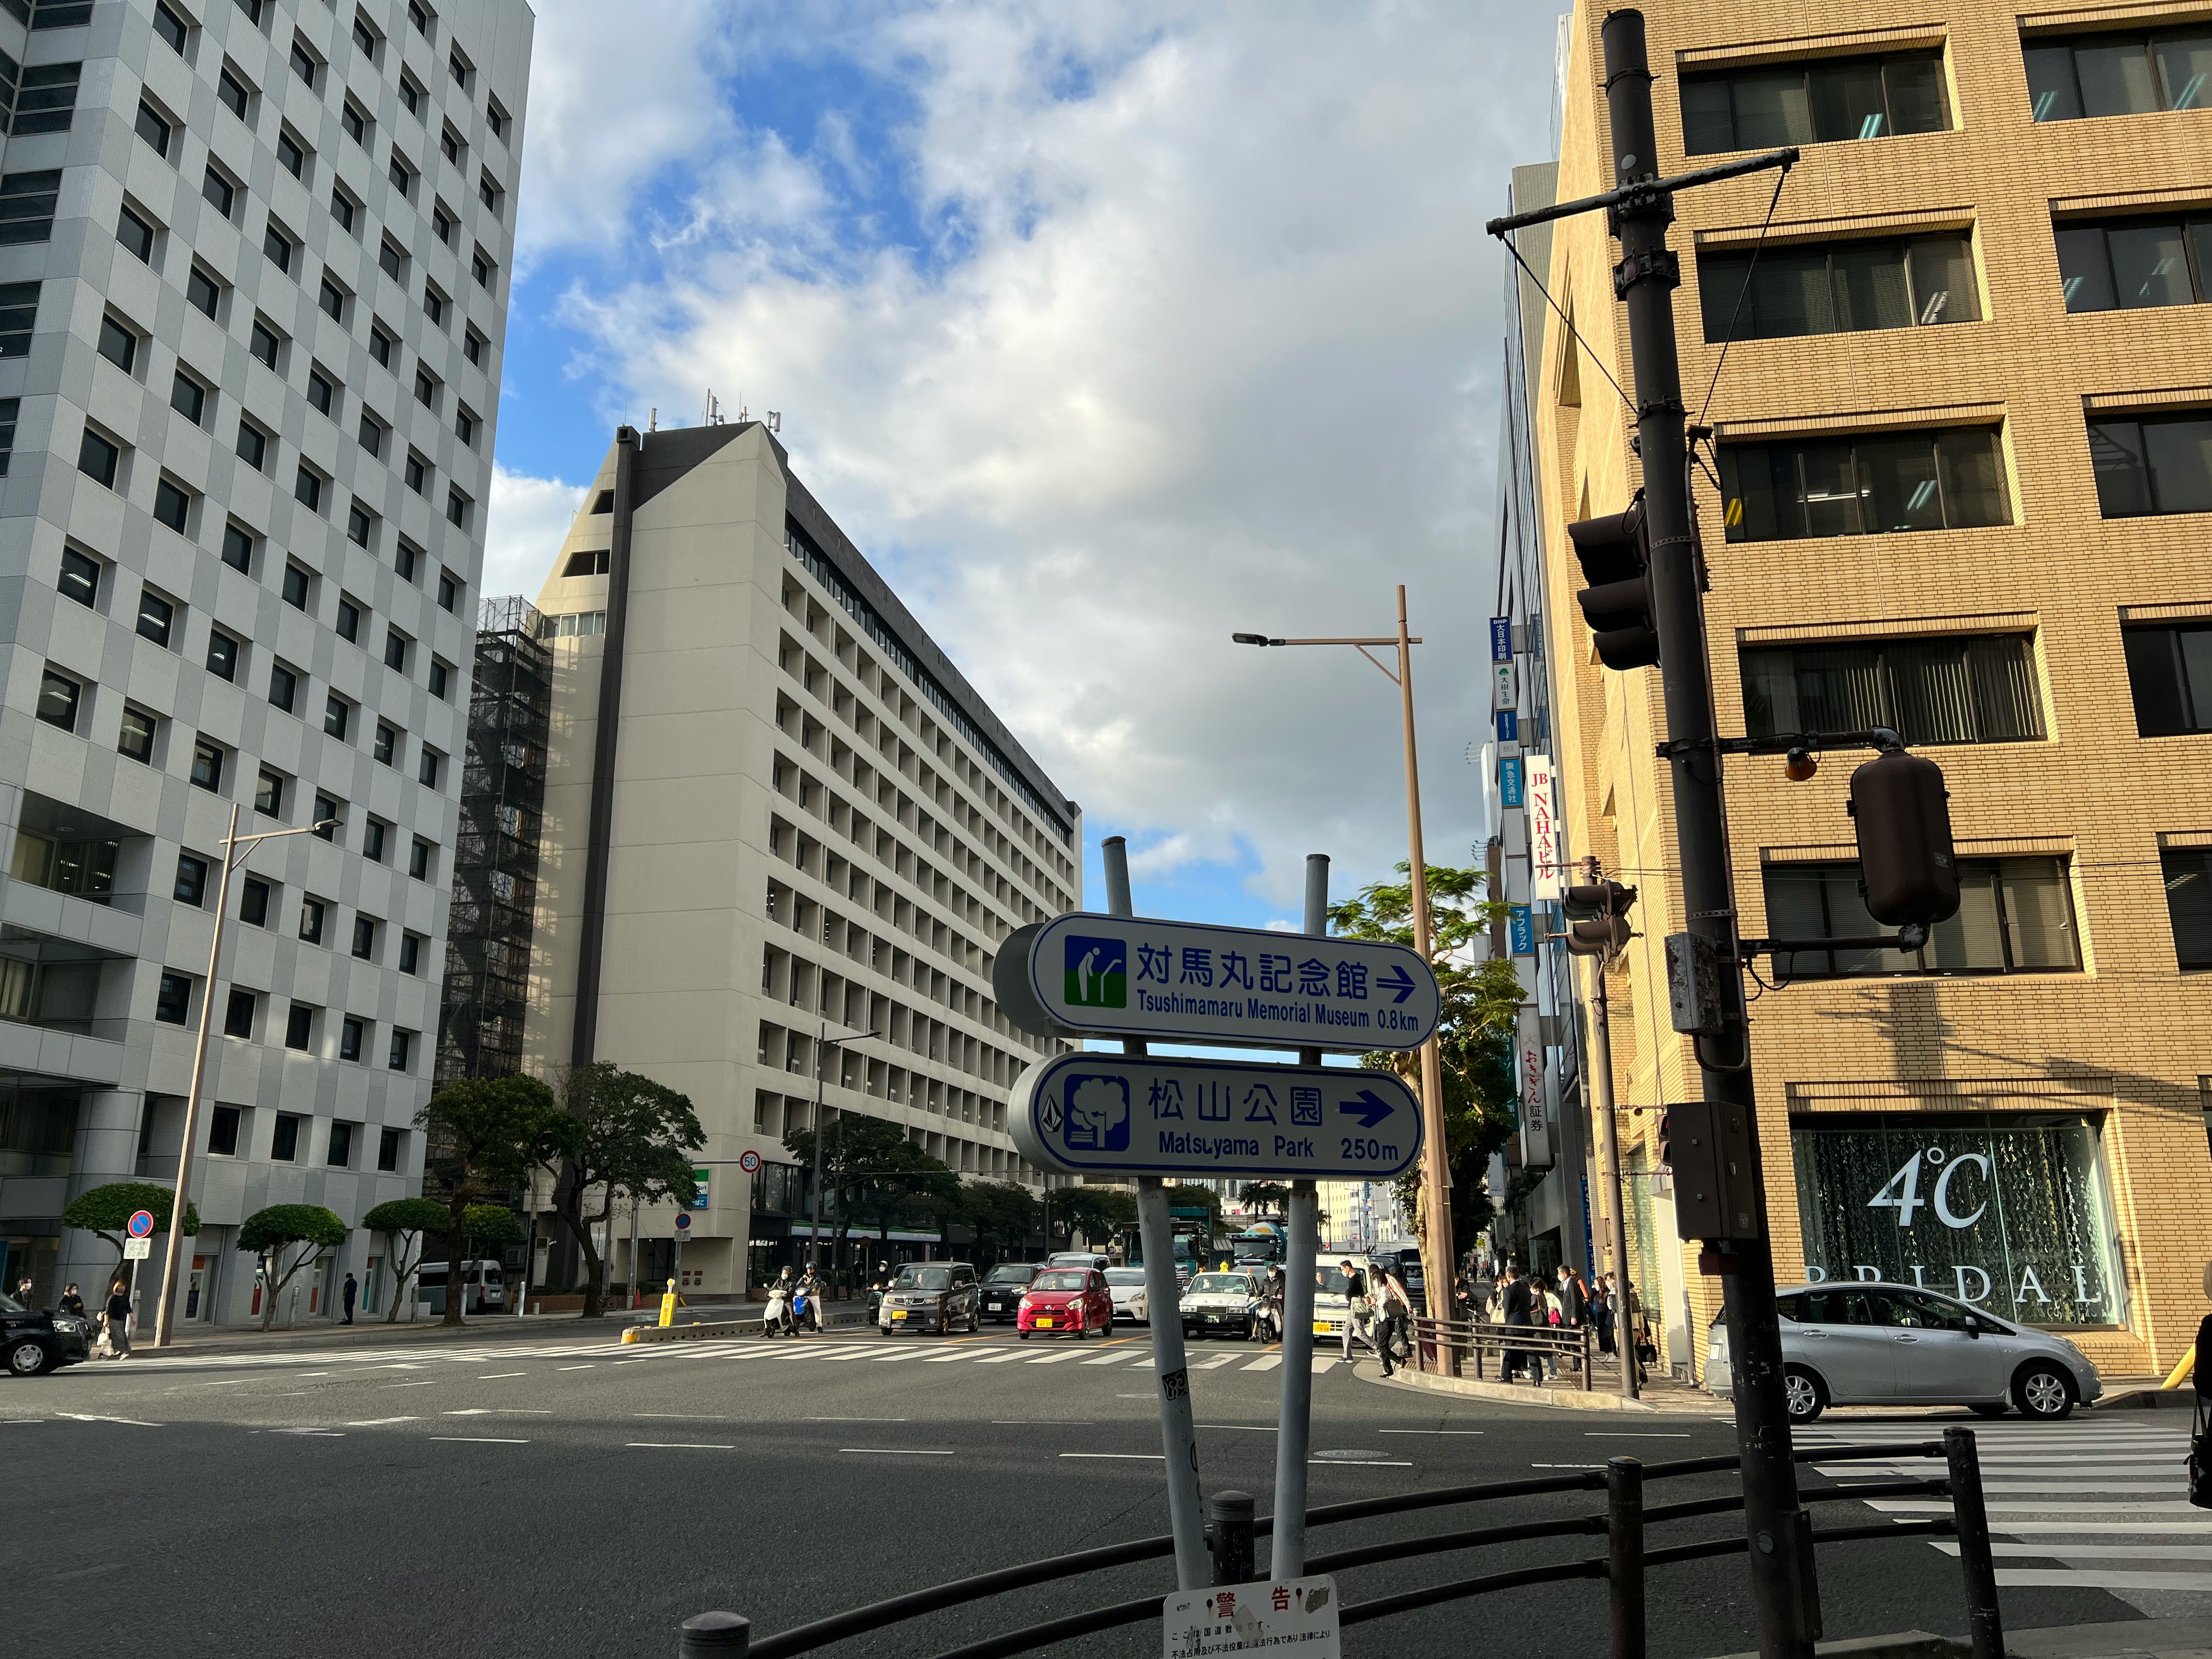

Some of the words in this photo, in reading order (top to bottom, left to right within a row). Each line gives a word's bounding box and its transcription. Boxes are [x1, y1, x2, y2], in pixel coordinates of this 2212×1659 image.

[1496, 624, 1506, 660] 大日本印刷
[1500, 676, 1510, 705] 大樹生命
[1505, 762, 1517, 803] 阪急交通社
[1531, 773, 1548, 787] JB
[1516, 910, 1527, 951] アフラック
[1137, 943, 1368, 1000] 対馬丸記念館
[1137, 989, 1243, 1018] Tsushimamaru
[1248, 998, 1310, 1023] Memorial
[1315, 1003, 1369, 1028] Museum
[1378, 1009, 1419, 1031] 0.8km
[1148, 1077, 1323, 1127] 松山公園
[744, 1156, 756, 1167] 50
[1159, 1131, 1259, 1159] Matsuyama
[1274, 1135, 1314, 1158] Park
[1341, 1138, 1398, 1160] 250m
